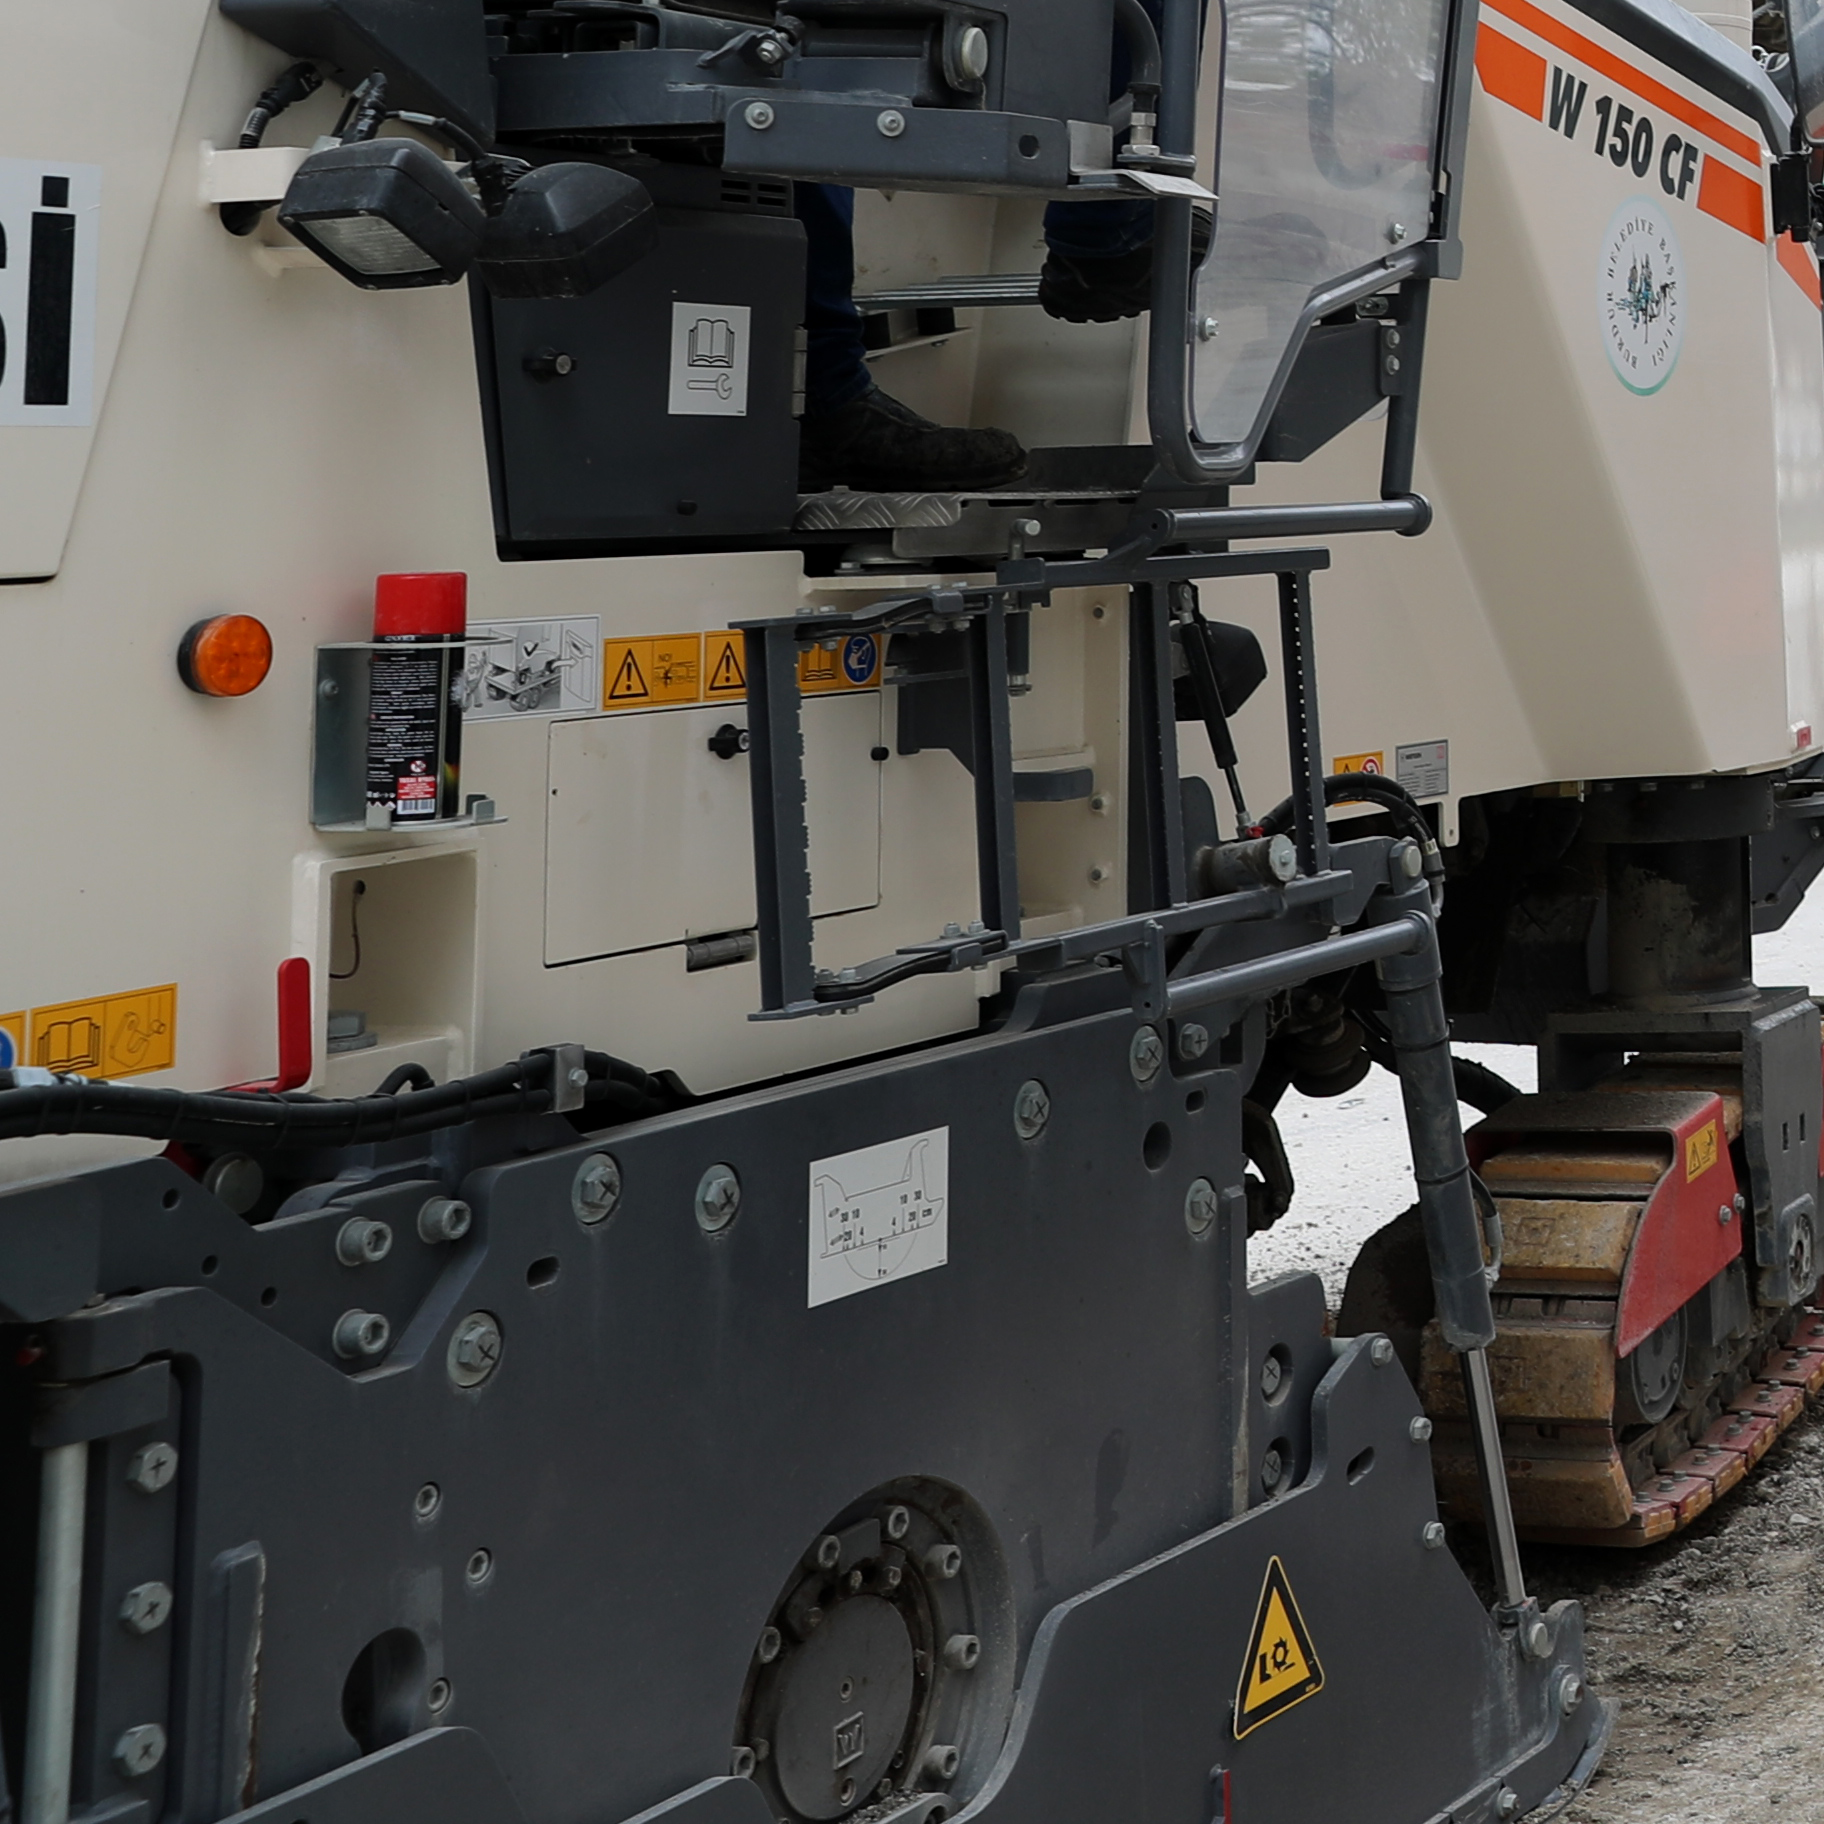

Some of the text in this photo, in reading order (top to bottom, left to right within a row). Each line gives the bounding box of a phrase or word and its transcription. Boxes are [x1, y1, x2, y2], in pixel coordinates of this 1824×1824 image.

[1548, 65, 1699, 201] W 150 CF
[899, 1194, 908, 1204] 10
[891, 1217, 897, 1227] 4
[859, 1226, 865, 1237] 4
